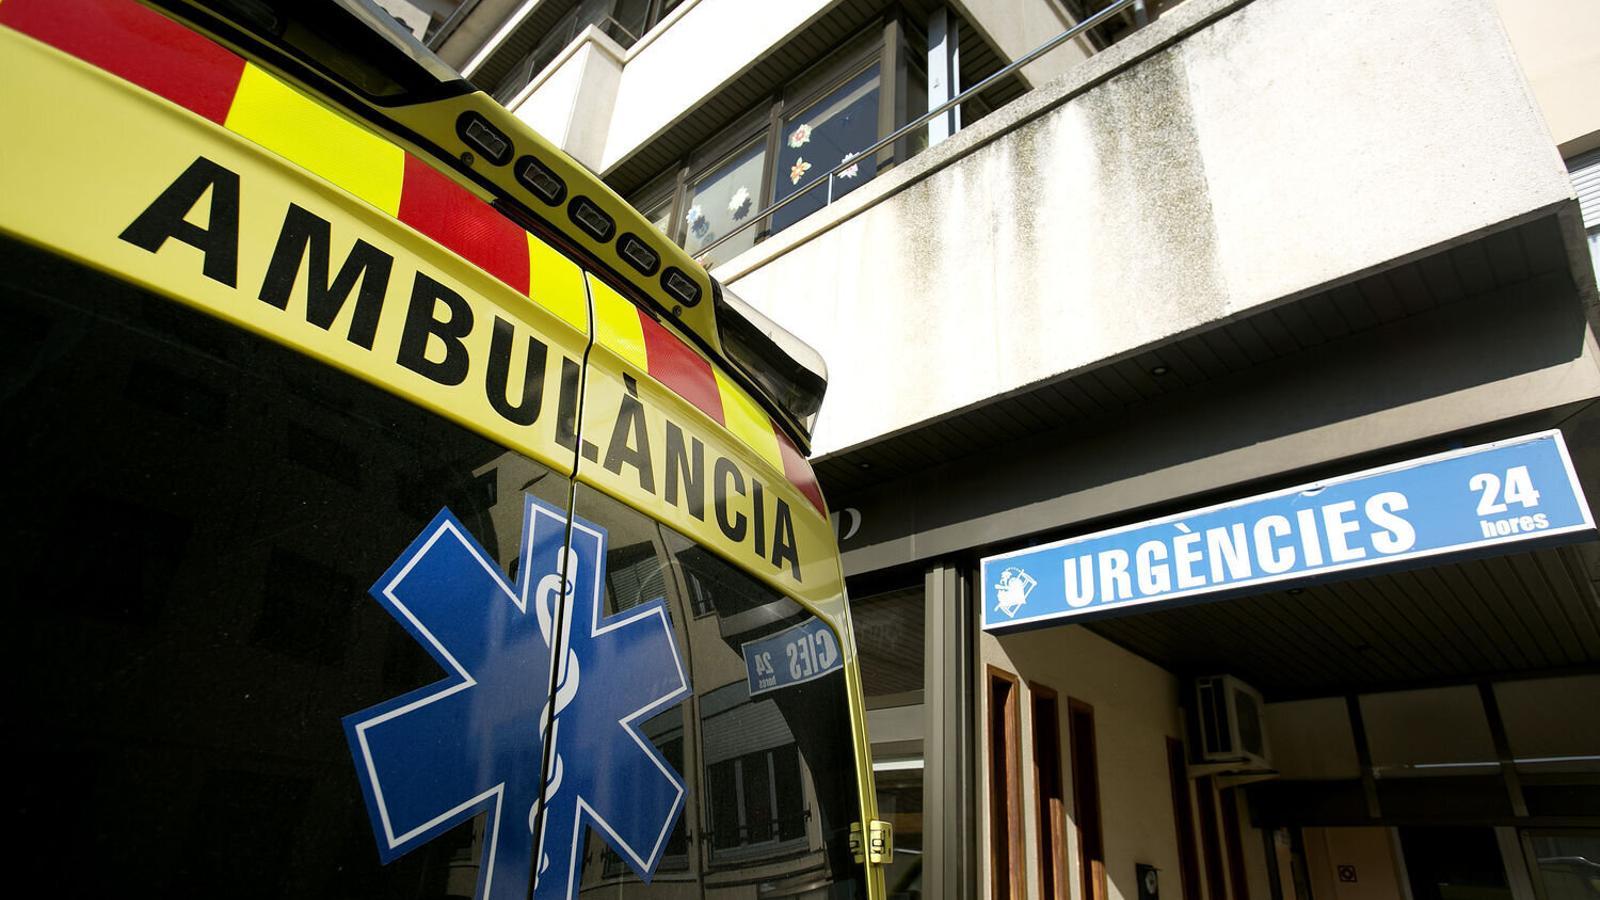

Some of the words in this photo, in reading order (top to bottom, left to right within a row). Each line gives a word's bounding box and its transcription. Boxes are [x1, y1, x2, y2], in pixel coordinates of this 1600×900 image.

[119, 156, 802, 583] AMBULÀNCIA
[1469, 465, 1540, 516] 24
[1480, 510, 1549, 539] hores
[1063, 491, 1417, 609] URGÈNCIES
